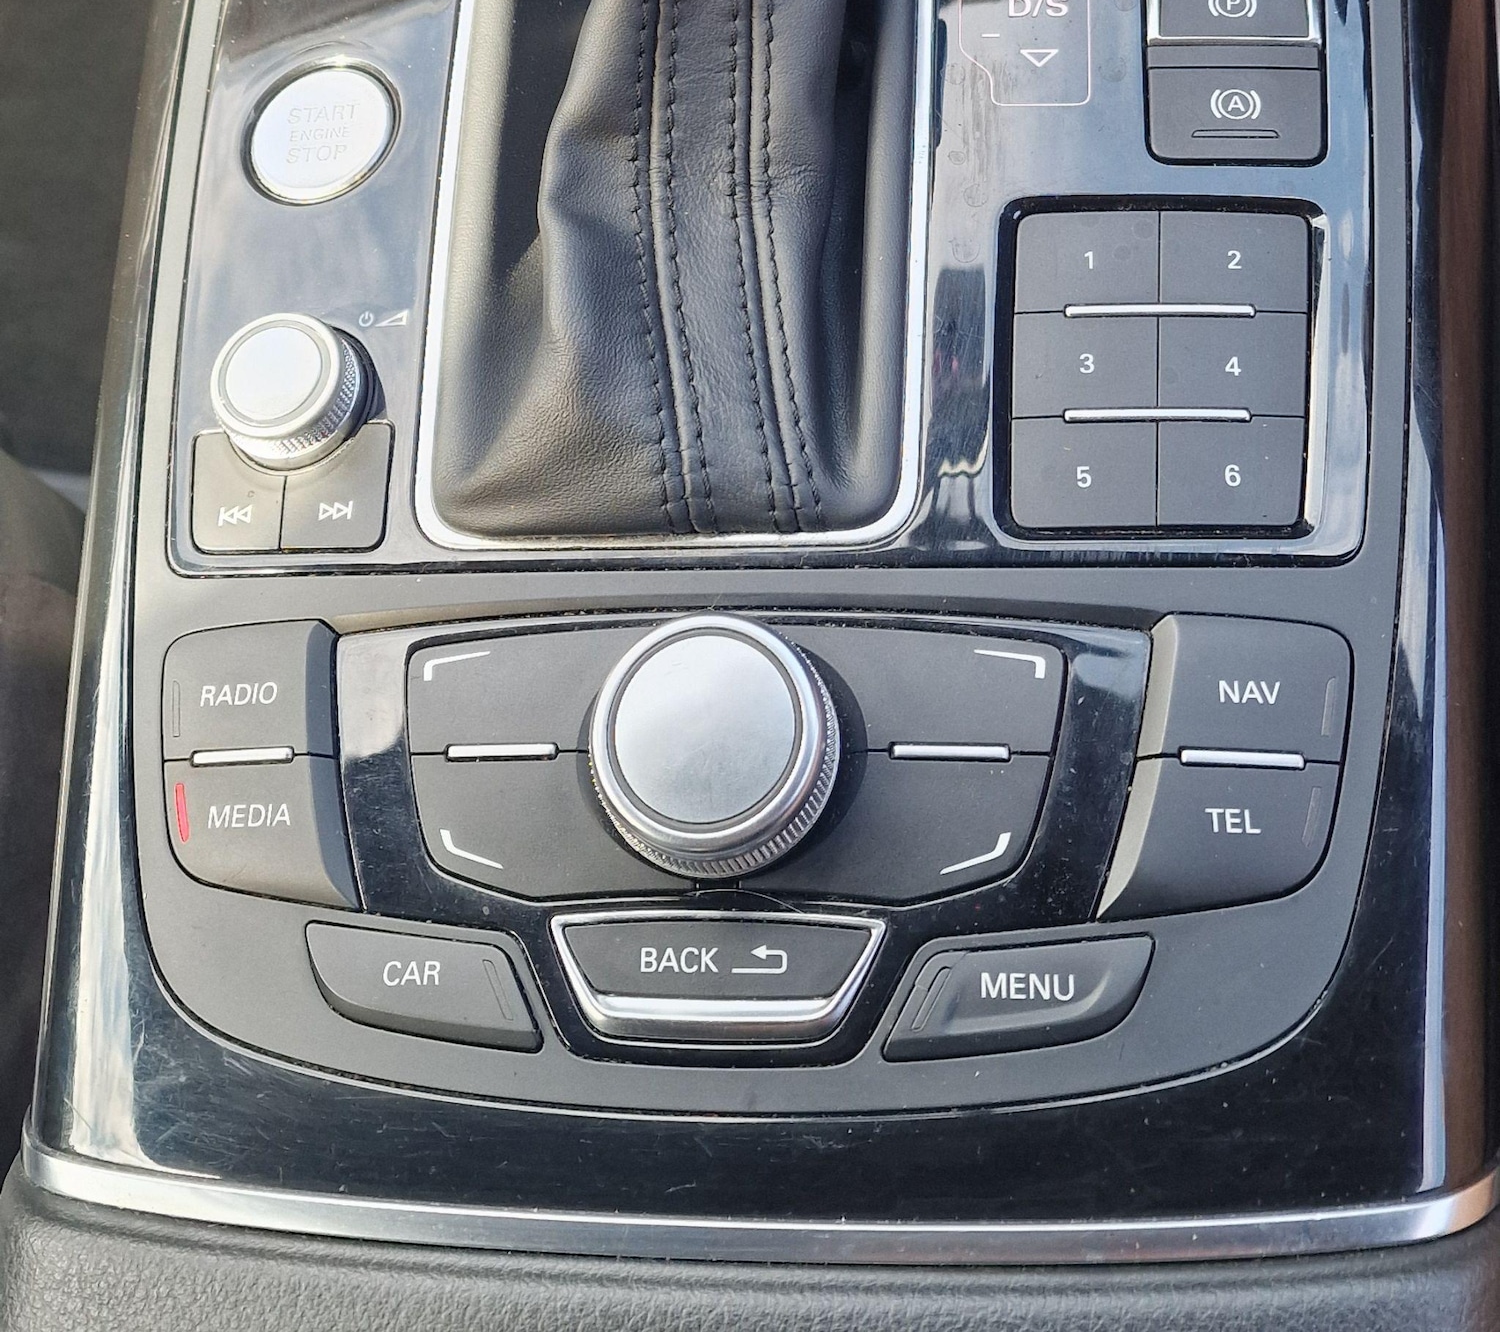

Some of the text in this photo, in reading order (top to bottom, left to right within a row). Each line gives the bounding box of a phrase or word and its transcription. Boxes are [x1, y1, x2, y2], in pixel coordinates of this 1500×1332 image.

[287, 102, 360, 125] START
[289, 126, 351, 142] ENGINE
[286, 144, 347, 164] STOP
[1084, 251, 1094, 270] 1
[1227, 250, 1242, 270] 2
[1079, 353, 1095, 374] 3
[1224, 356, 1242, 377] 4
[1075, 466, 1093, 489] 5
[1224, 464, 1242, 487] 6
[199, 681, 278, 707] RADIO
[1218, 680, 1281, 705] NAV
[207, 803, 291, 829] MEDIA
[1204, 808, 1262, 834] TEL
[640, 946, 719, 974] BACK
[382, 960, 441, 987] CAR
[980, 972, 1075, 1001] MENU
